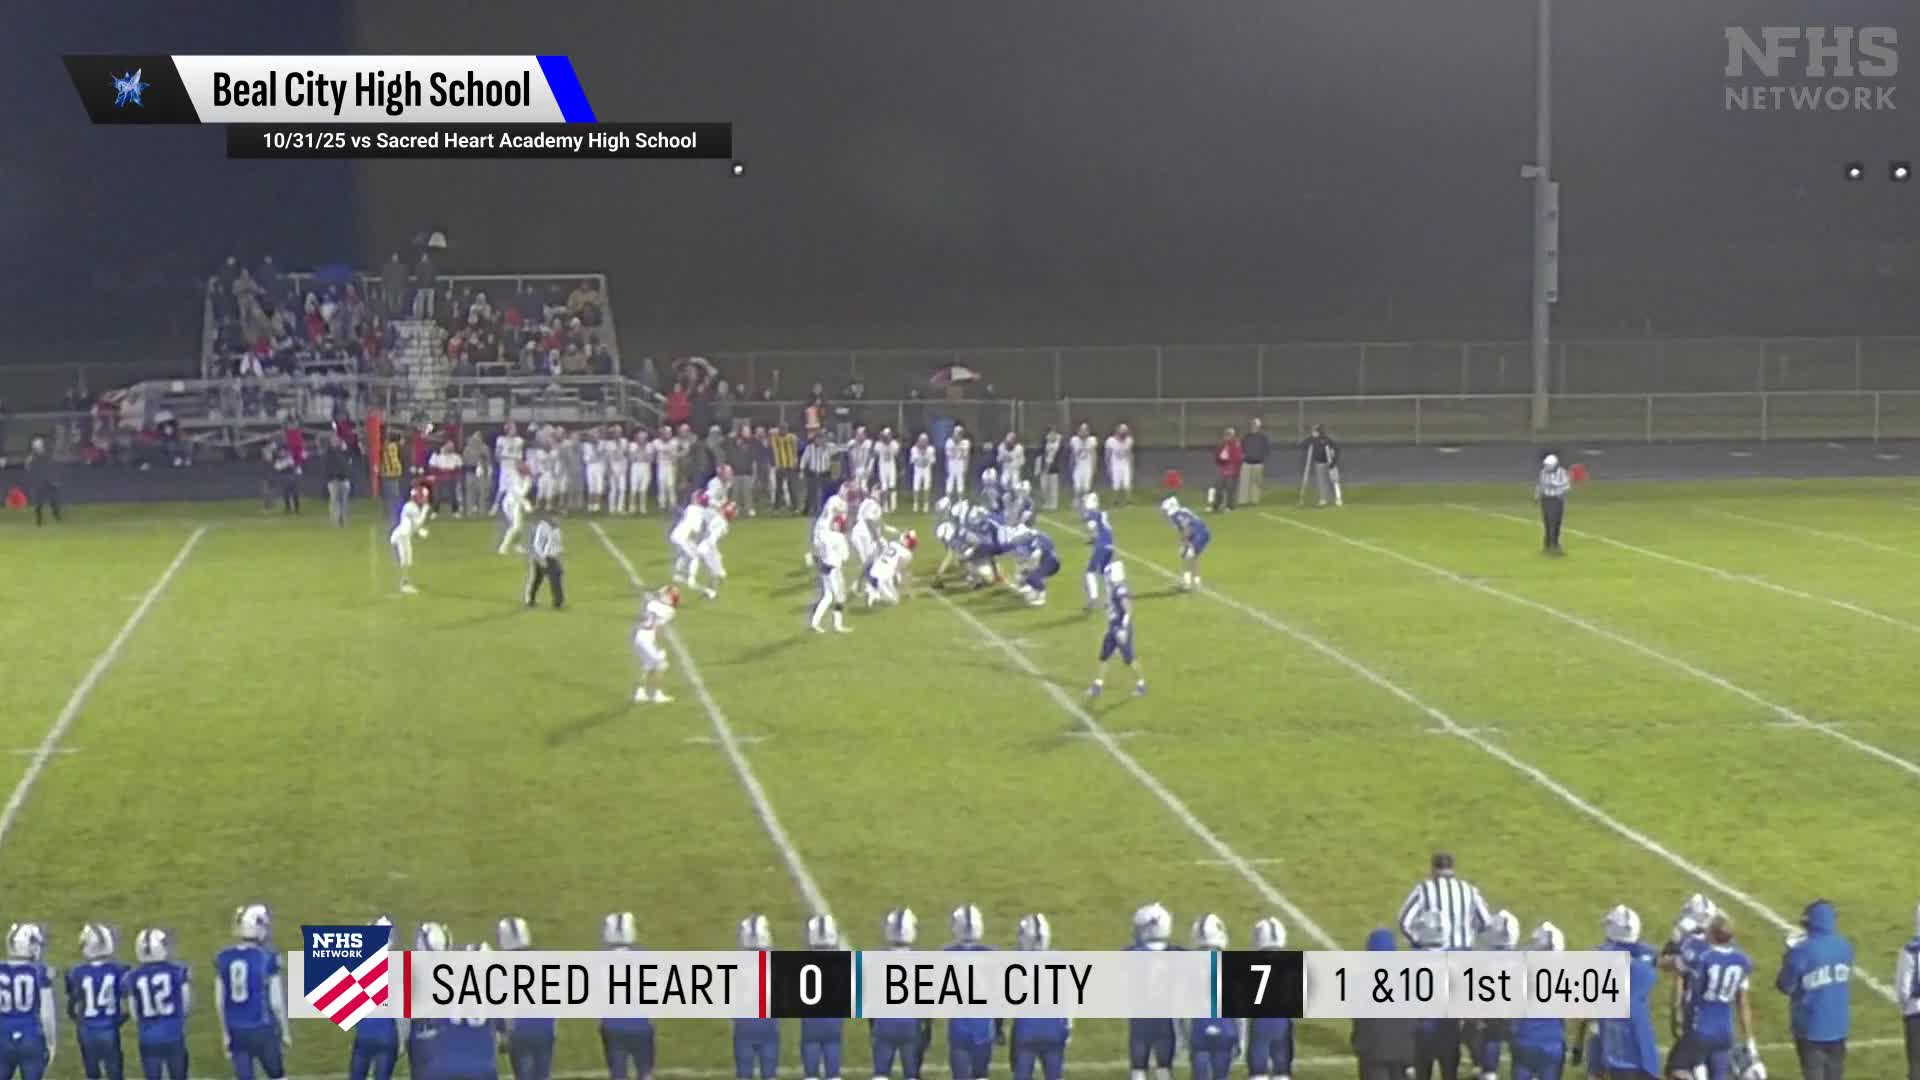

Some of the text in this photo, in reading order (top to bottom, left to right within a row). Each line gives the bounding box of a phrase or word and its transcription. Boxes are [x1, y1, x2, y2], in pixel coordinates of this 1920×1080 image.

[82, 974, 116, 1017] 14
[136, 973, 175, 1017] 12
[1703, 964, 1742, 1001] 10
